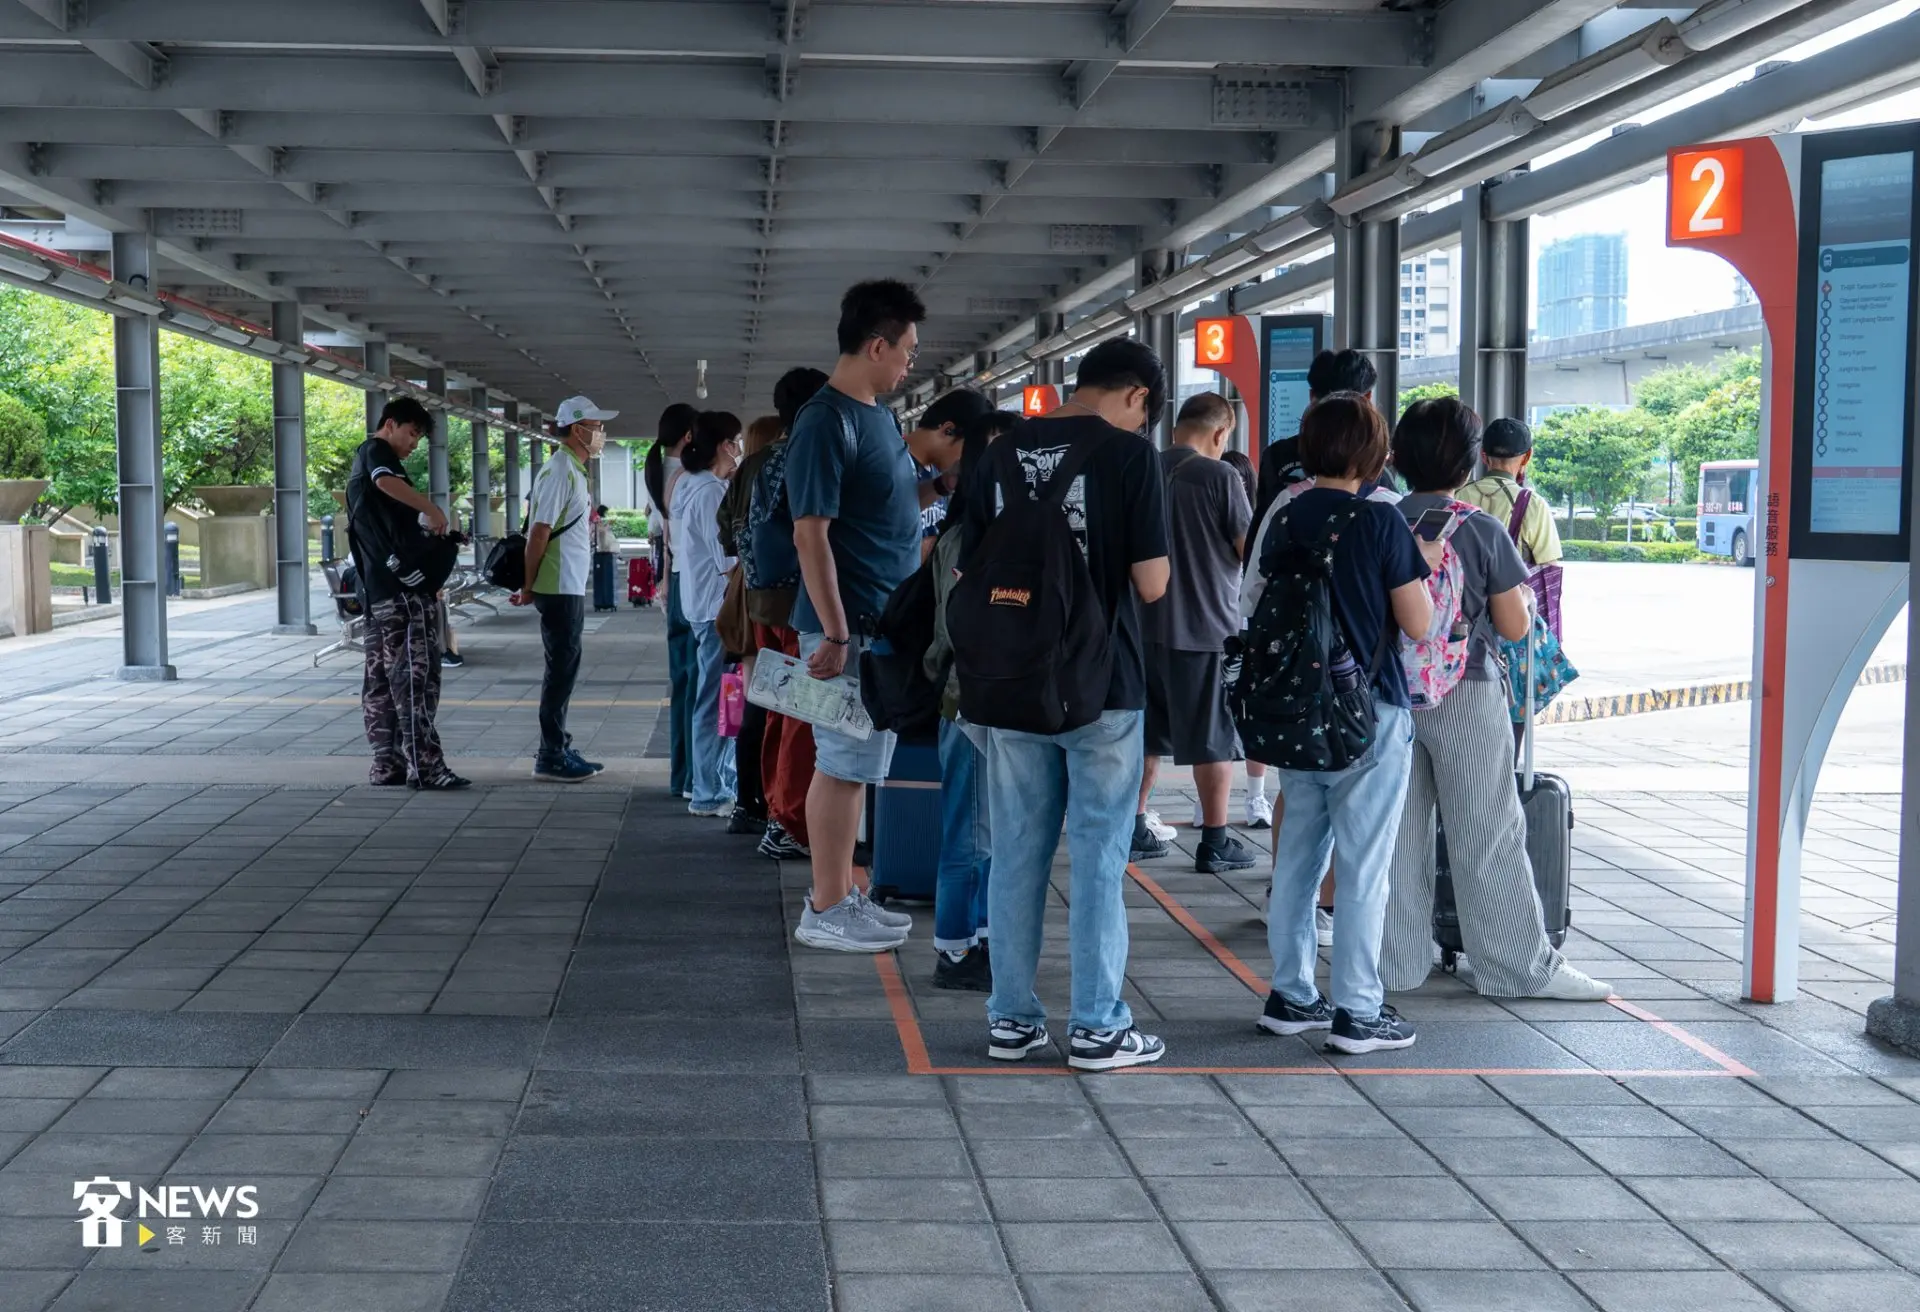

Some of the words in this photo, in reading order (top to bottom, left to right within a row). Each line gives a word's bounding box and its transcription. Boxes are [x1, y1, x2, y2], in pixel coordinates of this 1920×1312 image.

[1689, 157, 1725, 232] 2
[1206, 324, 1225, 361] 3
[1029, 392, 1042, 413] 4
[1765, 492, 1780, 557] 語音服務
[816, 919, 845, 937] HOKA
[997, 1020, 1013, 1029] NIKE
